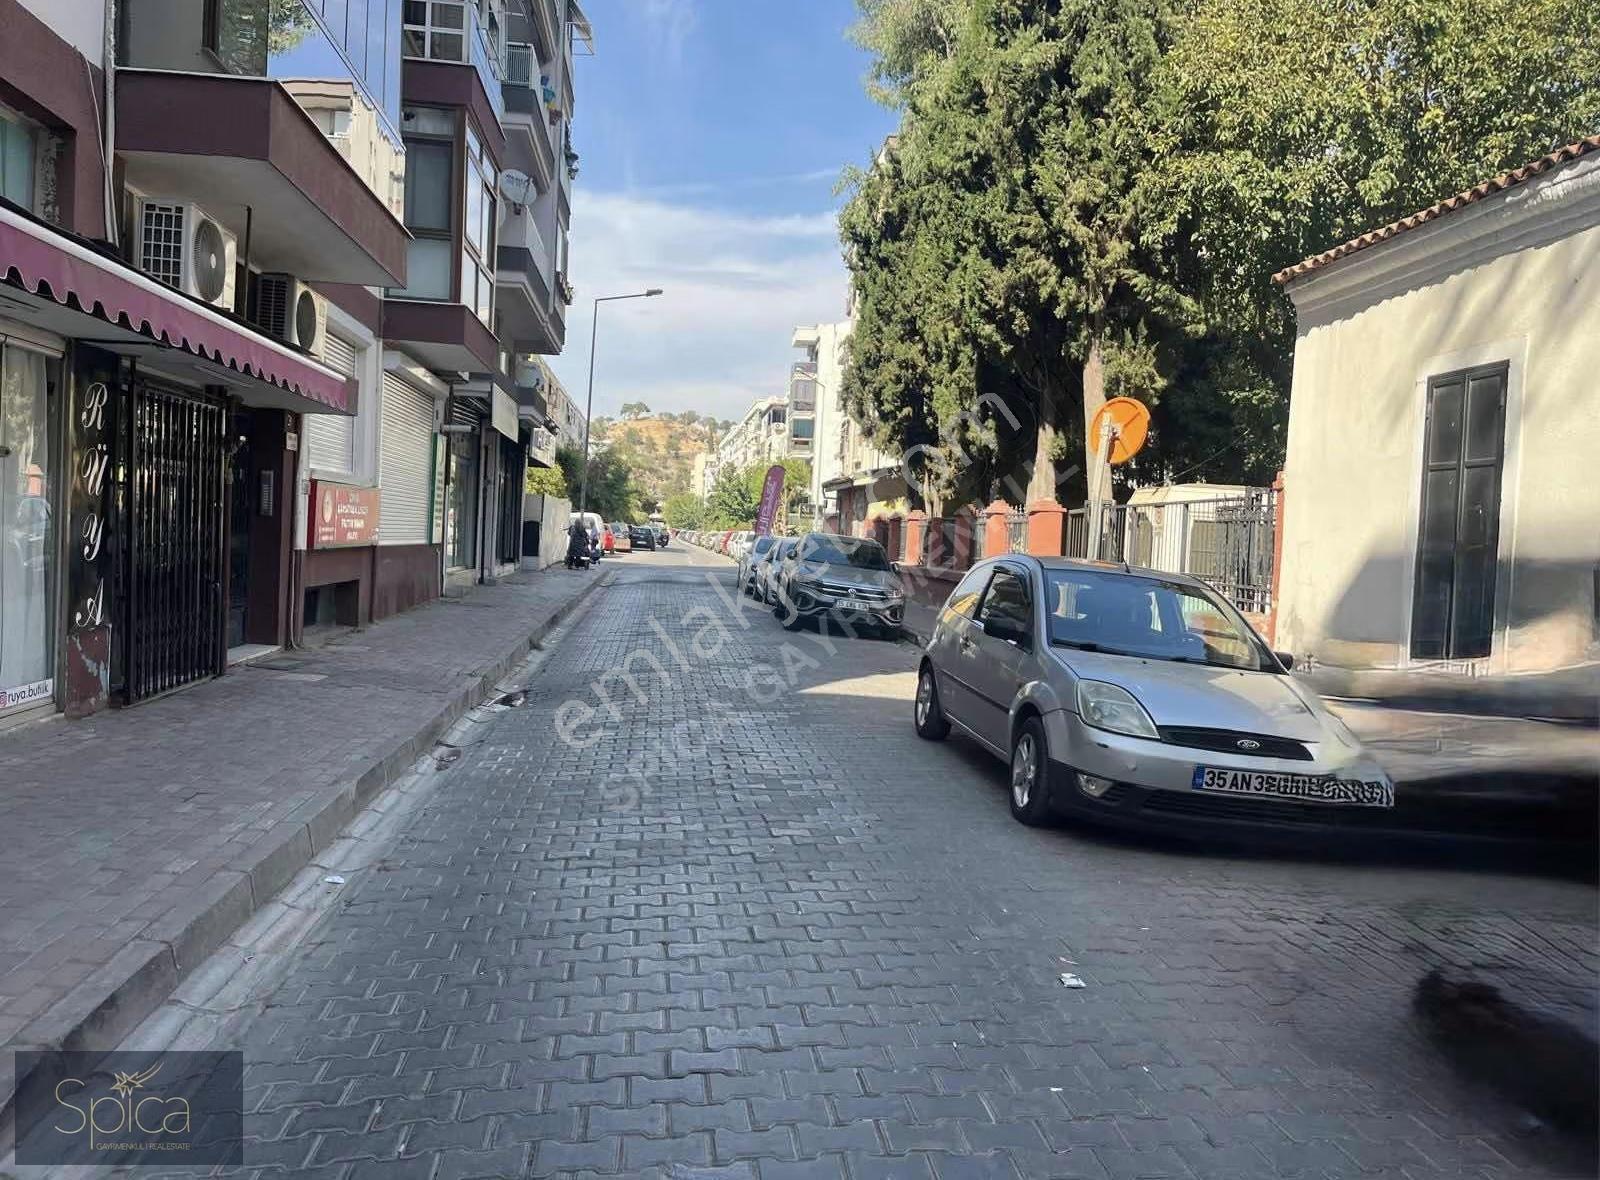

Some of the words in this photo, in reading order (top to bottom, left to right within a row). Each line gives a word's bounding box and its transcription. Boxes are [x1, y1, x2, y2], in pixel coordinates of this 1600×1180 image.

[76, 382, 108, 627] RÜYA
[1204, 770, 1228, 789] 35
[1230, 772, 1251, 791] AN
